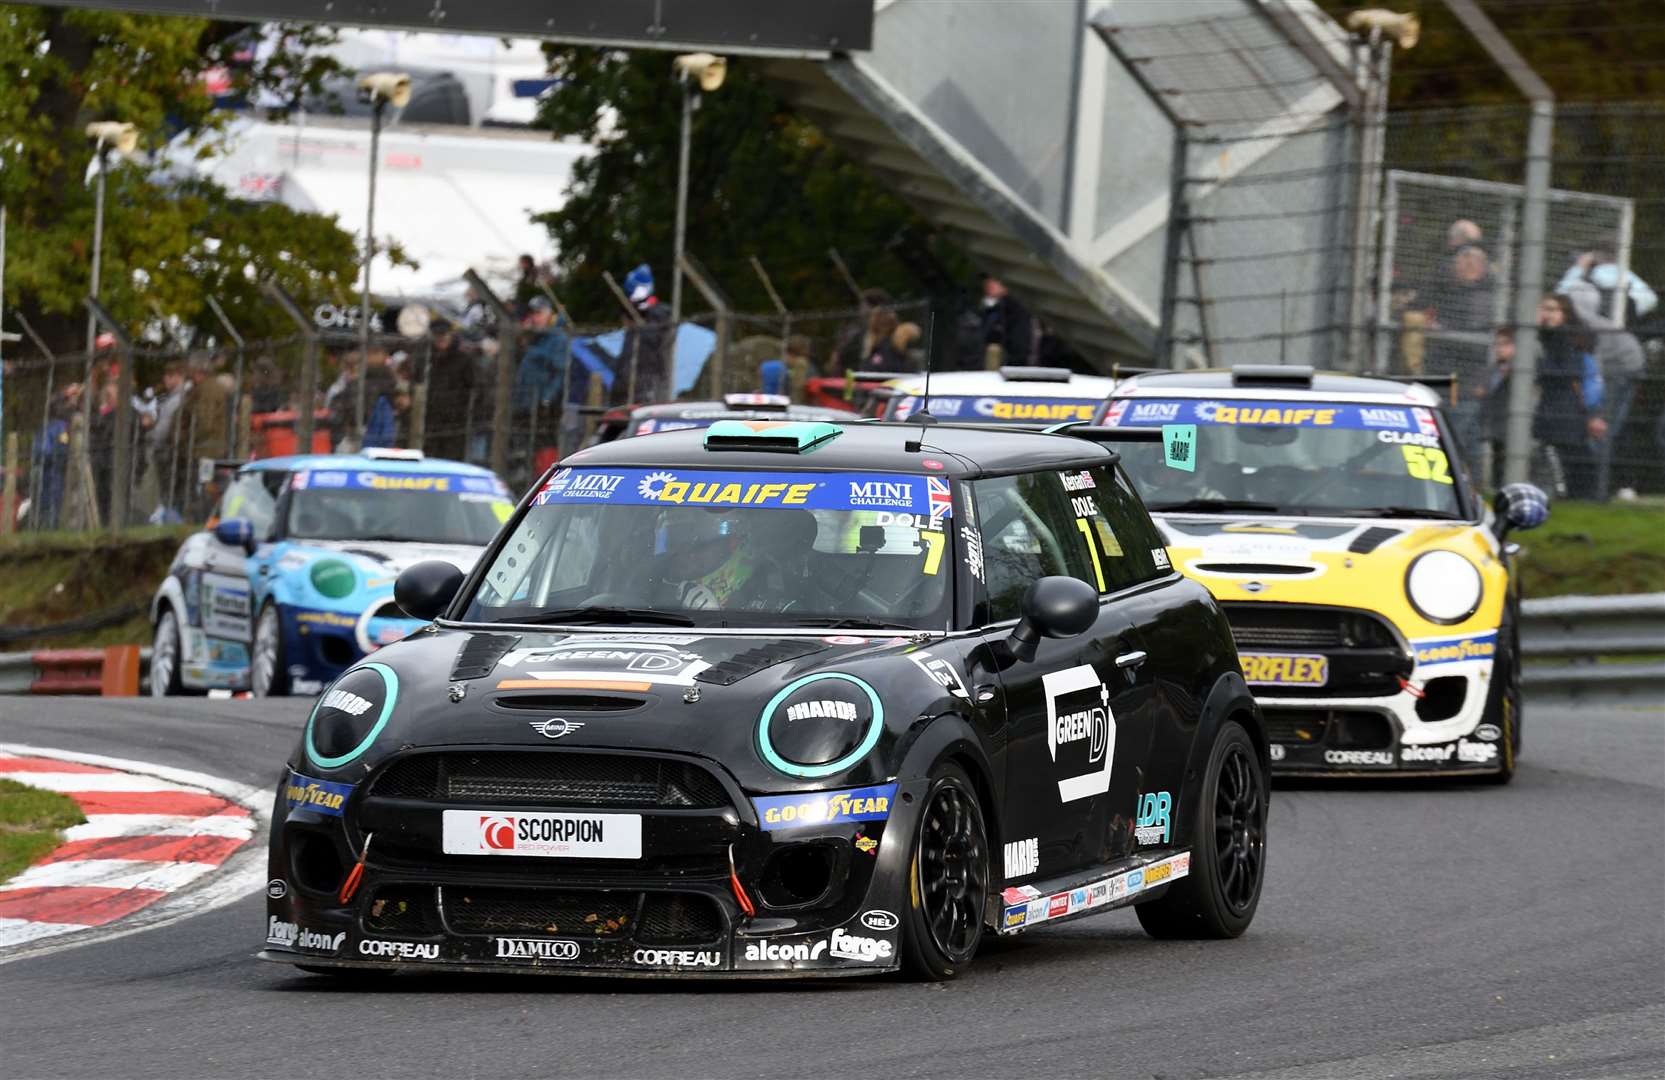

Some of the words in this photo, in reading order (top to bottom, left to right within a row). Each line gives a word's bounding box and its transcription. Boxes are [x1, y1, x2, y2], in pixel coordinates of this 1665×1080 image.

[993, 402, 1095, 419] QUAIFE
[1215, 407, 1335, 424] QUAIFE
[1378, 430, 1439, 448] CLARK
[1402, 445, 1454, 485] 52
[568, 474, 624, 491] MINI
[849, 481, 913, 499] MINI
[1060, 472, 1088, 491] Kenan
[563, 490, 613, 498] CHALLENGE
[660, 481, 816, 504] QUAIFE
[849, 497, 912, 508] CHALLENGE
[1071, 496, 1098, 518] DOLE
[876, 511, 943, 531] DOLE
[1076, 518, 1106, 593] 1
[525, 651, 632, 663] GREEN
[1240, 655, 1325, 683] ERFLEX
[794, 700, 850, 720] HARD
[544, 721, 566, 733] MINI
[1056, 710, 1091, 745] GREEN
[1325, 751, 1393, 764] CORBEAU
[765, 794, 889, 823] GOODYEAR
[1136, 791, 1172, 843] LDR
[518, 818, 603, 843] SCORPION
[1004, 838, 1034, 879] HARD
[868, 917, 892, 927] HEL
[299, 927, 332, 950] alcon
[830, 928, 893, 962] forge
[496, 938, 579, 960] DAMICO
[633, 949, 721, 966] CORBEAU
[746, 940, 811, 961] alcon
